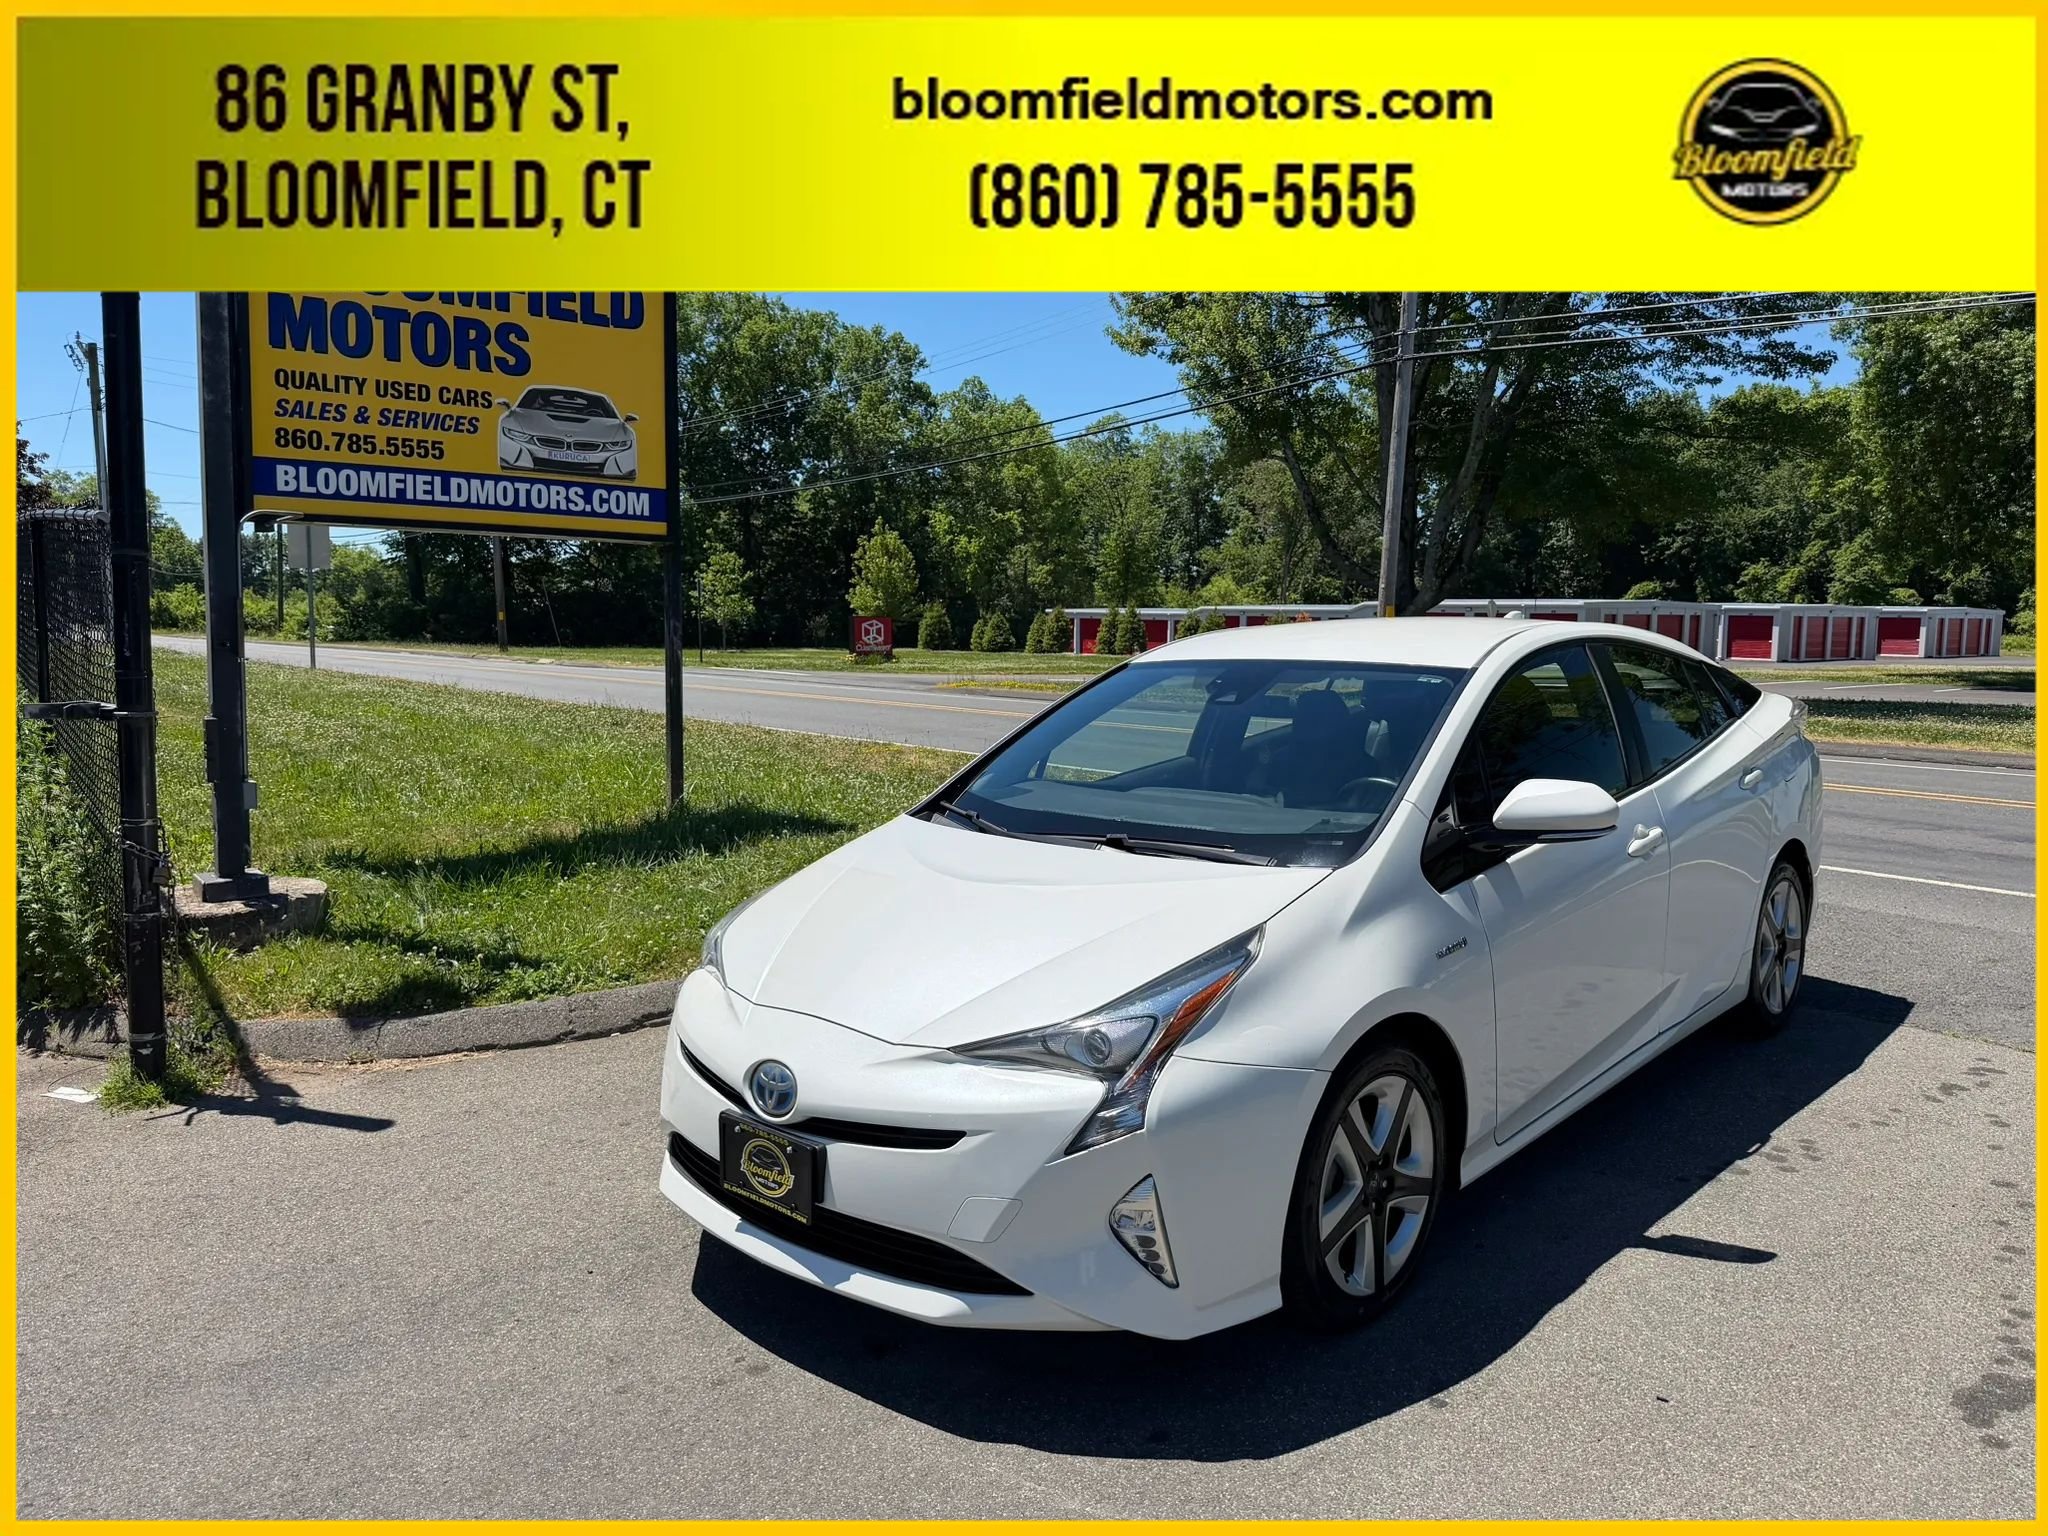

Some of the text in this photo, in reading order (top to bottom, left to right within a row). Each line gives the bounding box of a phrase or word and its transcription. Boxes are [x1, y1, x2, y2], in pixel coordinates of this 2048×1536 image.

[268, 292, 531, 377] MOTORS
[274, 368, 493, 409] QUALITY USED CARS
[274, 398, 480, 435] SALES & SERVICES
[274, 426, 445, 461] 860.785.5555
[275, 463, 651, 517] BLOOMFIELDMOTORS.COM
[743, 1160, 794, 1188] Bloomfield
